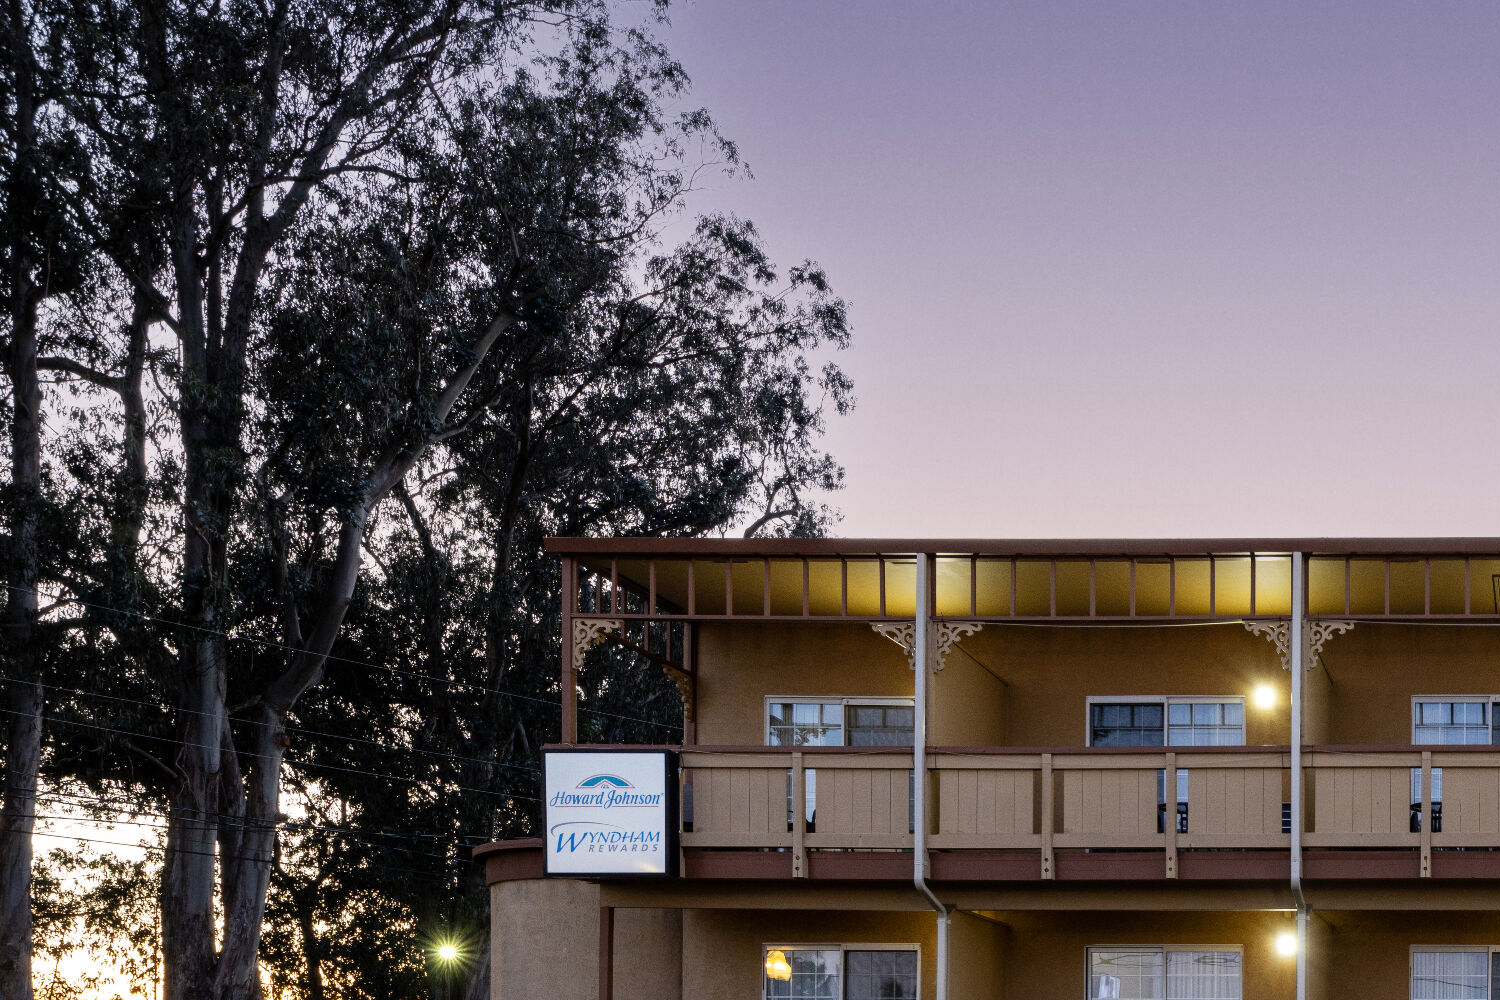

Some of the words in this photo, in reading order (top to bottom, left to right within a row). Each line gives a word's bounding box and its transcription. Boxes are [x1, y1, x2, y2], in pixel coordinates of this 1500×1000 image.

[550, 790, 605, 807] Howard
[604, 790, 660, 809] Johnson
[556, 831, 661, 854] WYNDHAM
[588, 843, 659, 853] REWARDS
